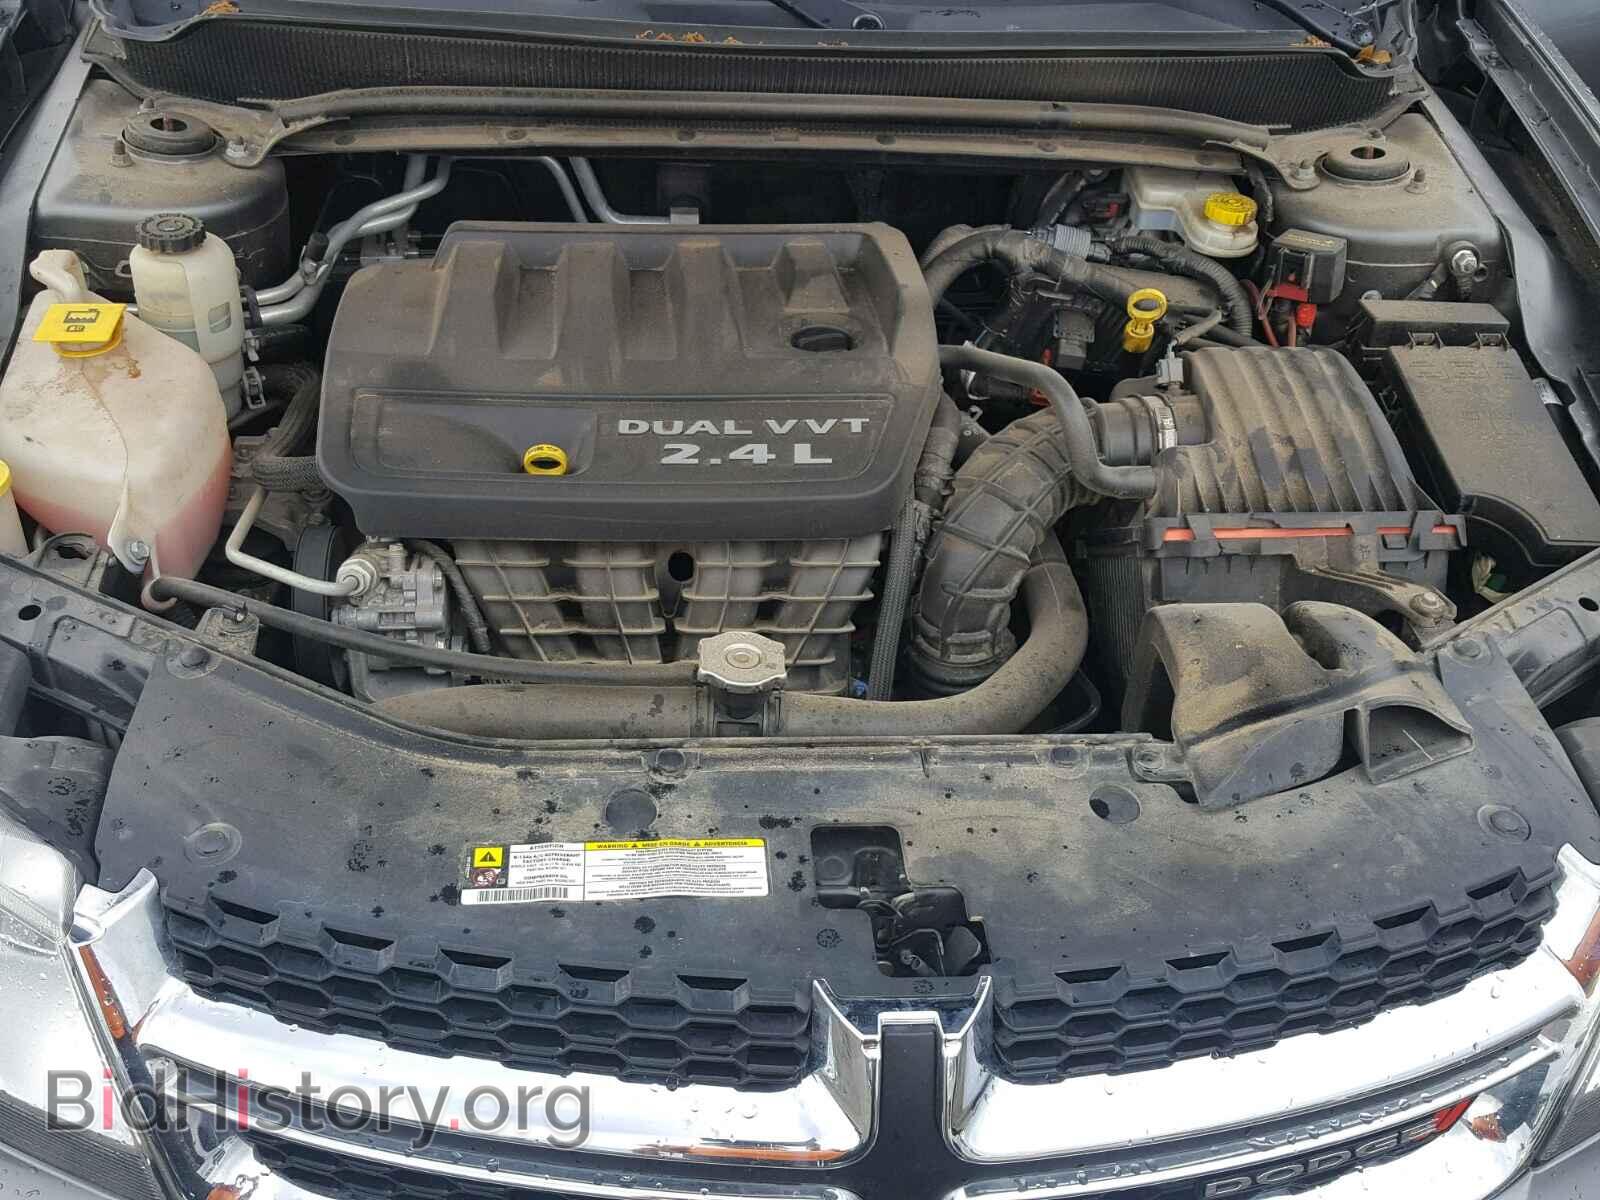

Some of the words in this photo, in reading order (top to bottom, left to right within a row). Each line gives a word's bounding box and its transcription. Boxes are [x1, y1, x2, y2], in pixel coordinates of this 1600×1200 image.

[618, 419, 752, 434] DUAL
[765, 418, 870, 434] VVT
[1205, 1118, 1438, 1198] DODGE
